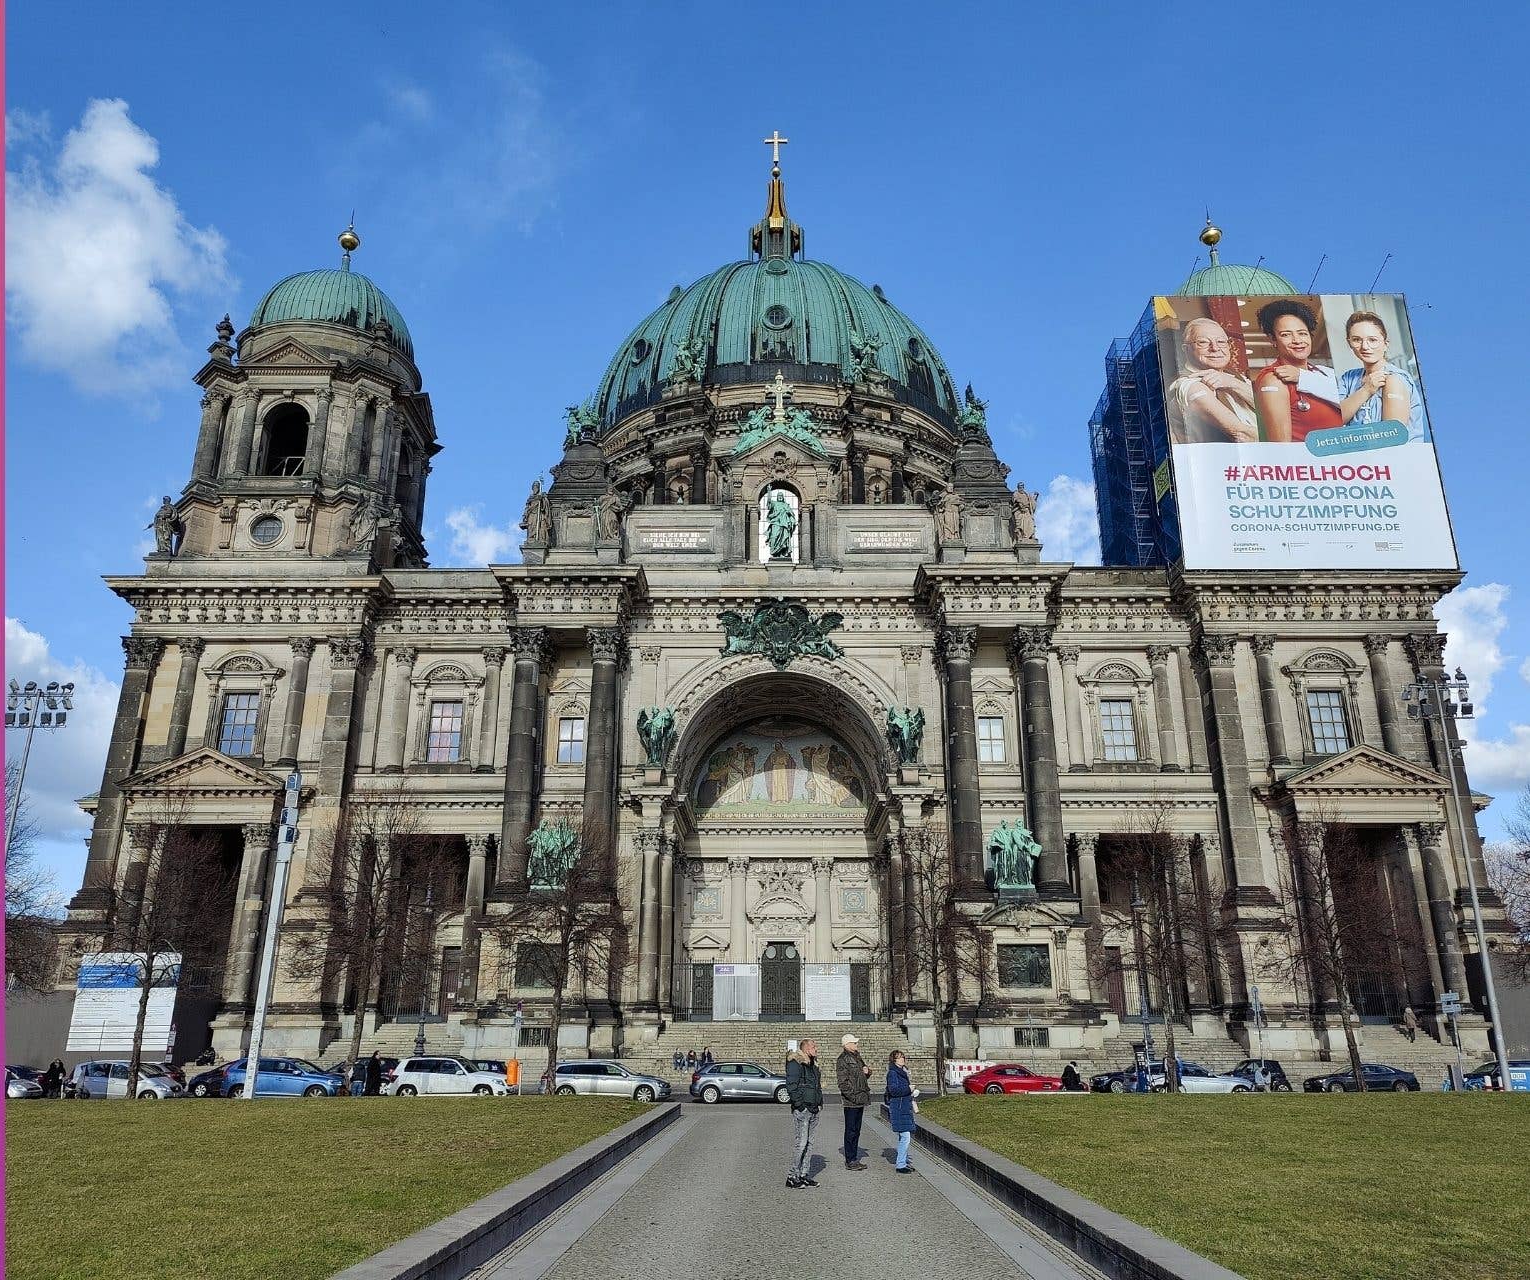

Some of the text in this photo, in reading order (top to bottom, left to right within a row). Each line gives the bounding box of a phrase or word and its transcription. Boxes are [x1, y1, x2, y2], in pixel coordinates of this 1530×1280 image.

[1315, 428, 1399, 448] Jetzt informieren!
[1224, 464, 1391, 481] #ÄRMELHOCH
[1226, 483, 1395, 500] FÜR DIE CORONA
[1229, 504, 1398, 519] SCHUTZIMPFUNG
[1230, 523, 1400, 532] CORONA-SCHUTZIMPFUNG.DE
